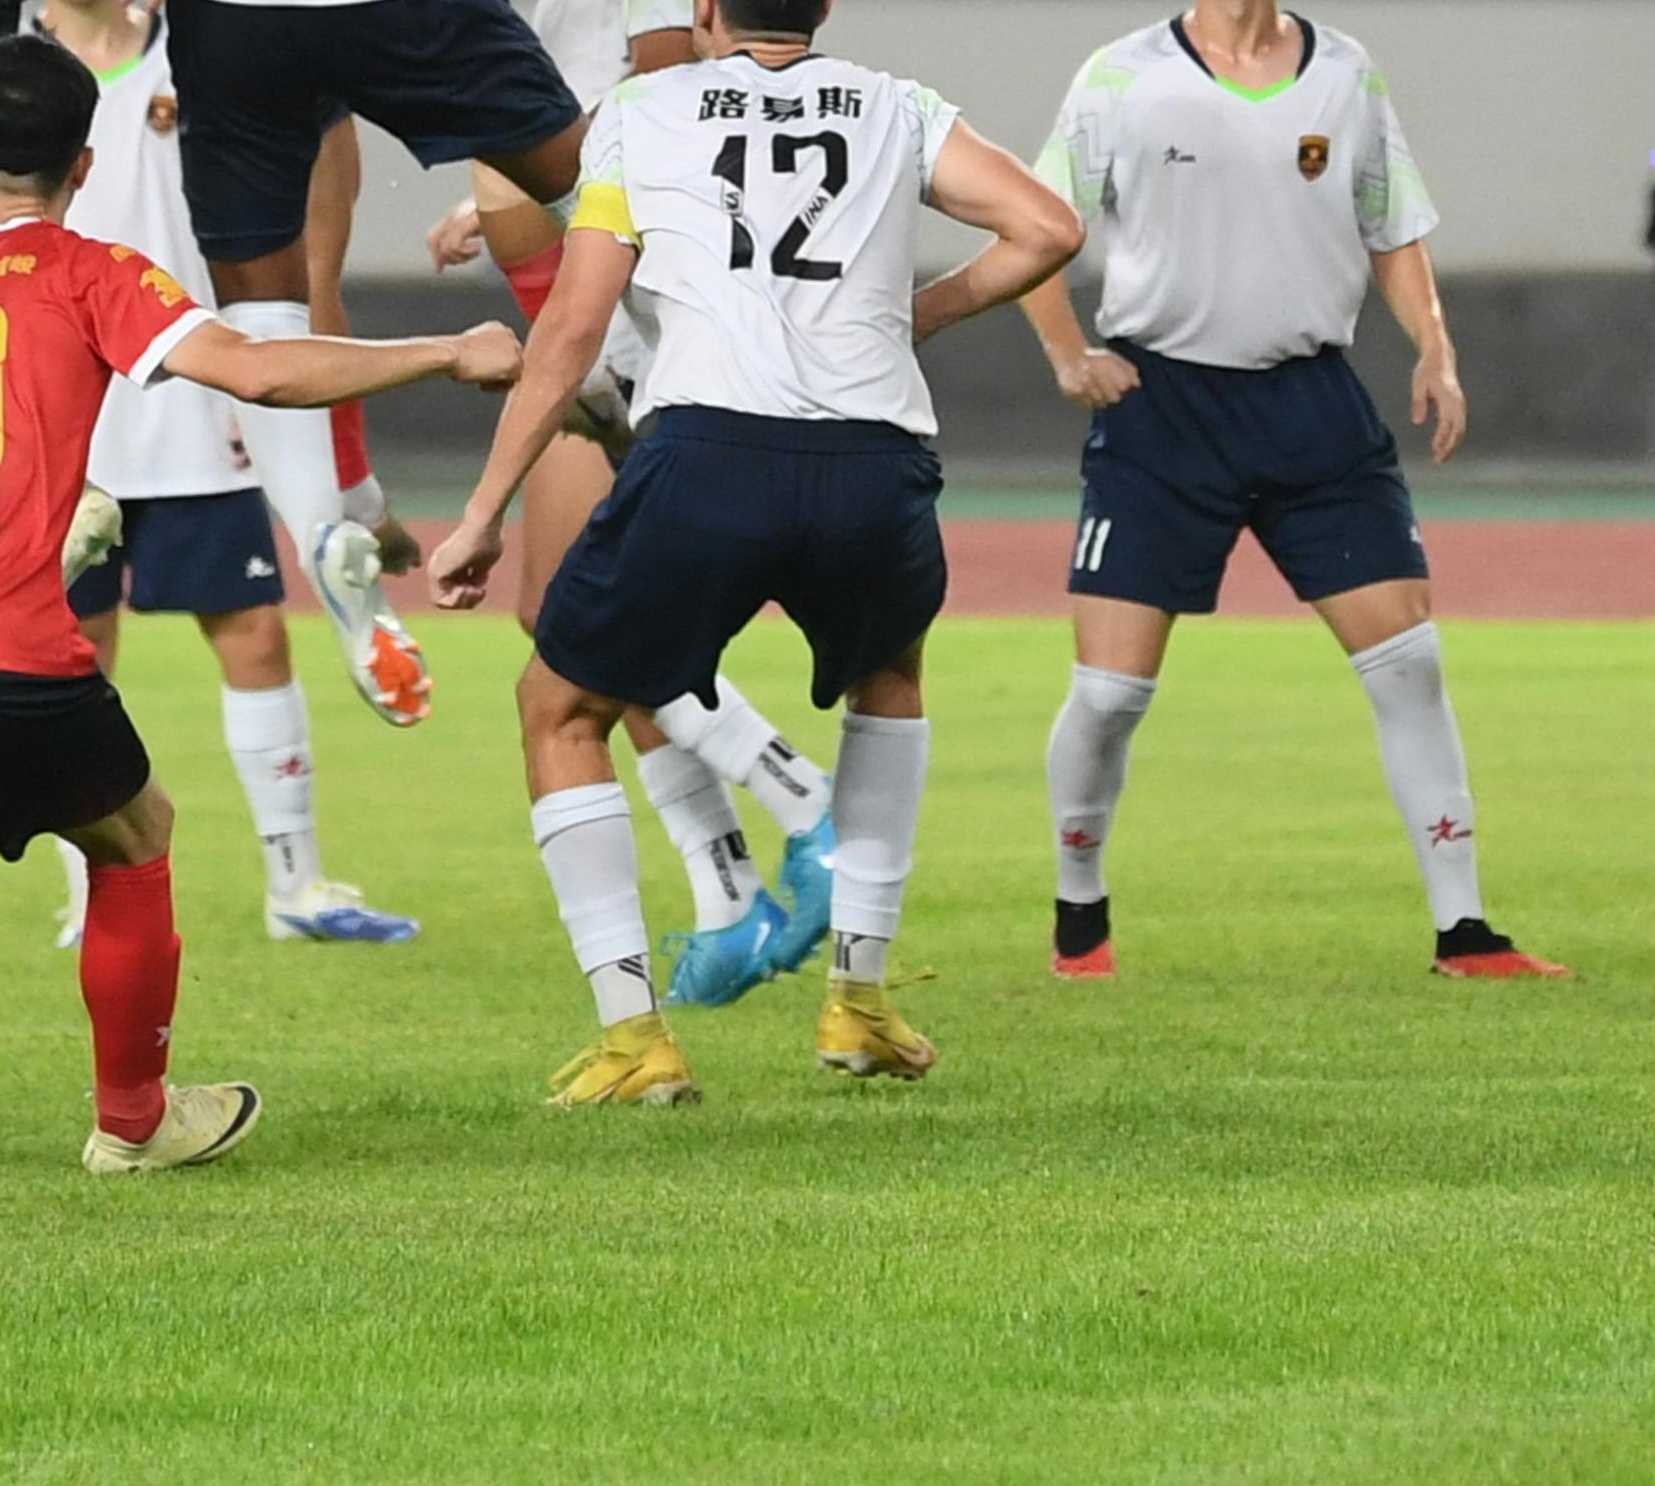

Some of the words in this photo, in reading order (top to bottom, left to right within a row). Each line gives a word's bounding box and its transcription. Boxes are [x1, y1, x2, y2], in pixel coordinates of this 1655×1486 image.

[697, 86, 863, 124] 路易斯
[711, 130, 849, 282] 12
[1074, 516, 1113, 572] 11
